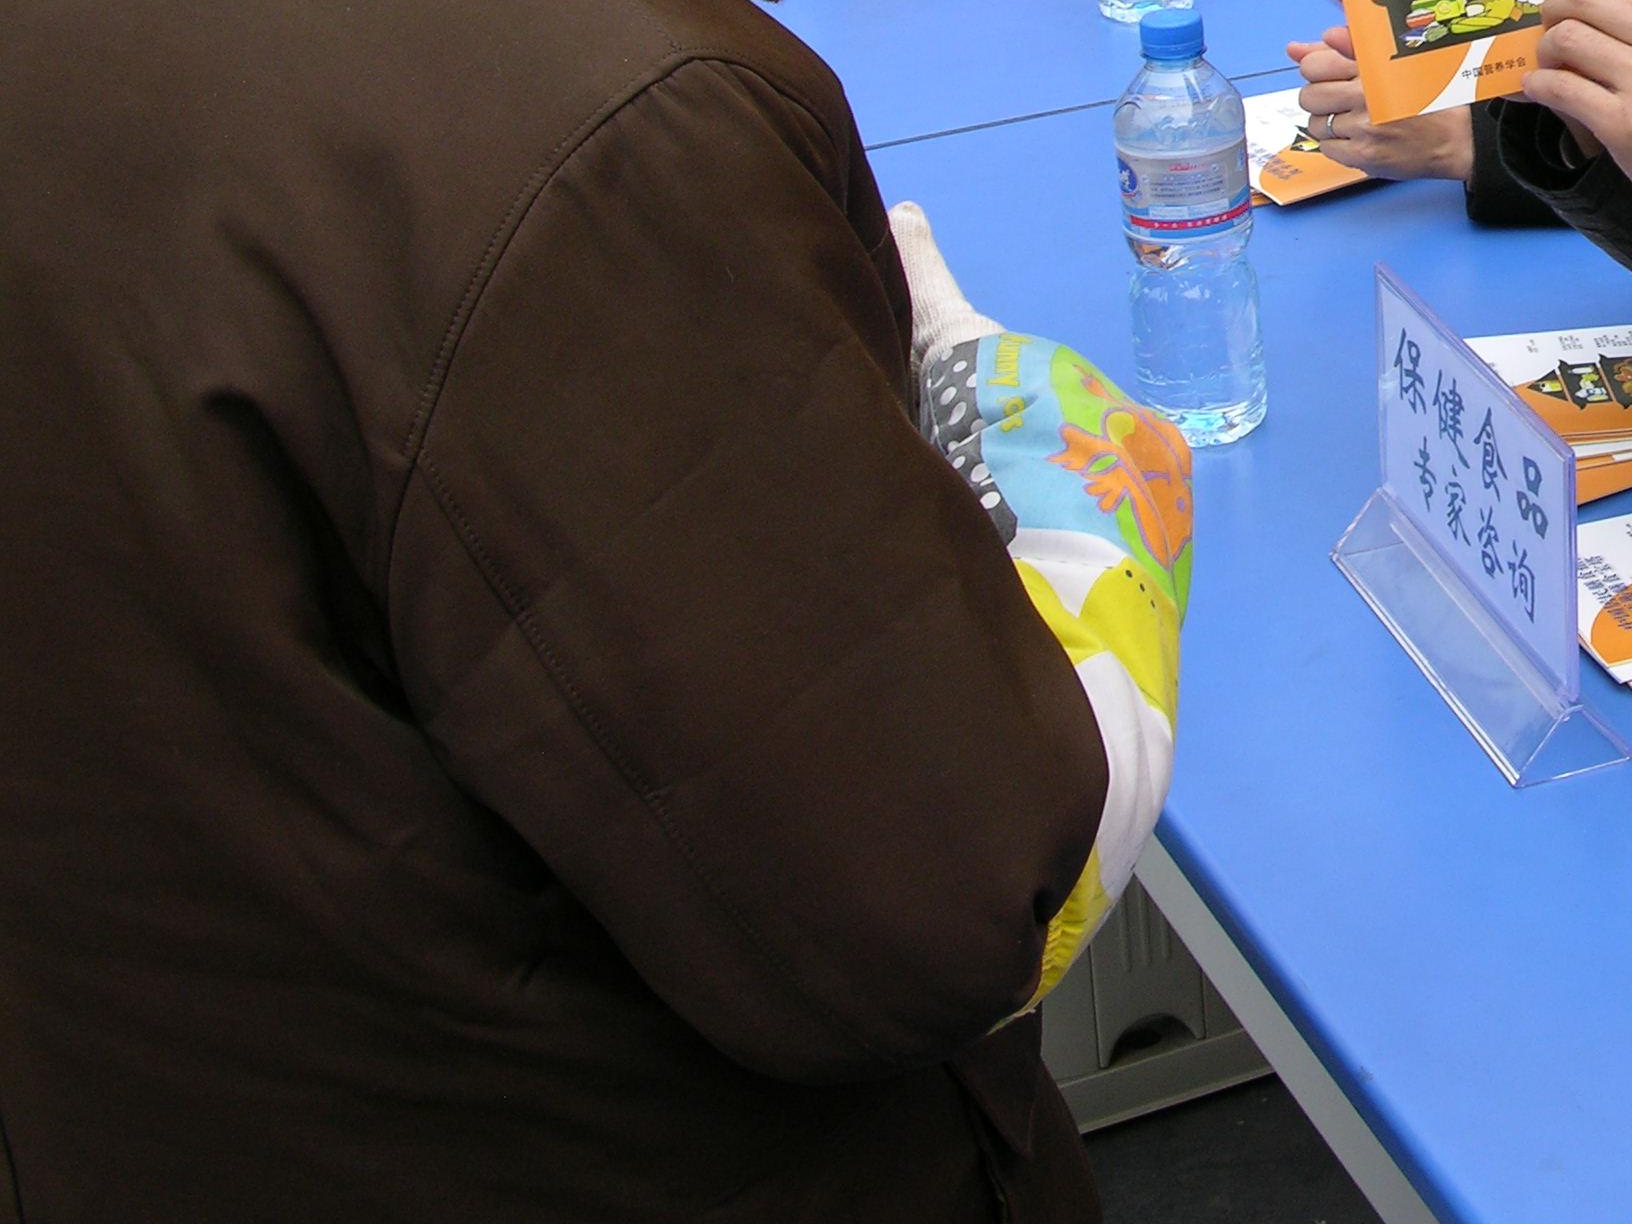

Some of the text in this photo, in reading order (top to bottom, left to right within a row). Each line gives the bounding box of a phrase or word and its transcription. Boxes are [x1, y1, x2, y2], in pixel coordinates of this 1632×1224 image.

[1461, 56, 1527, 79] 中国营养学会
[1393, 326, 1549, 539] 保健食品
[1413, 436, 1536, 624] 专家咨询
